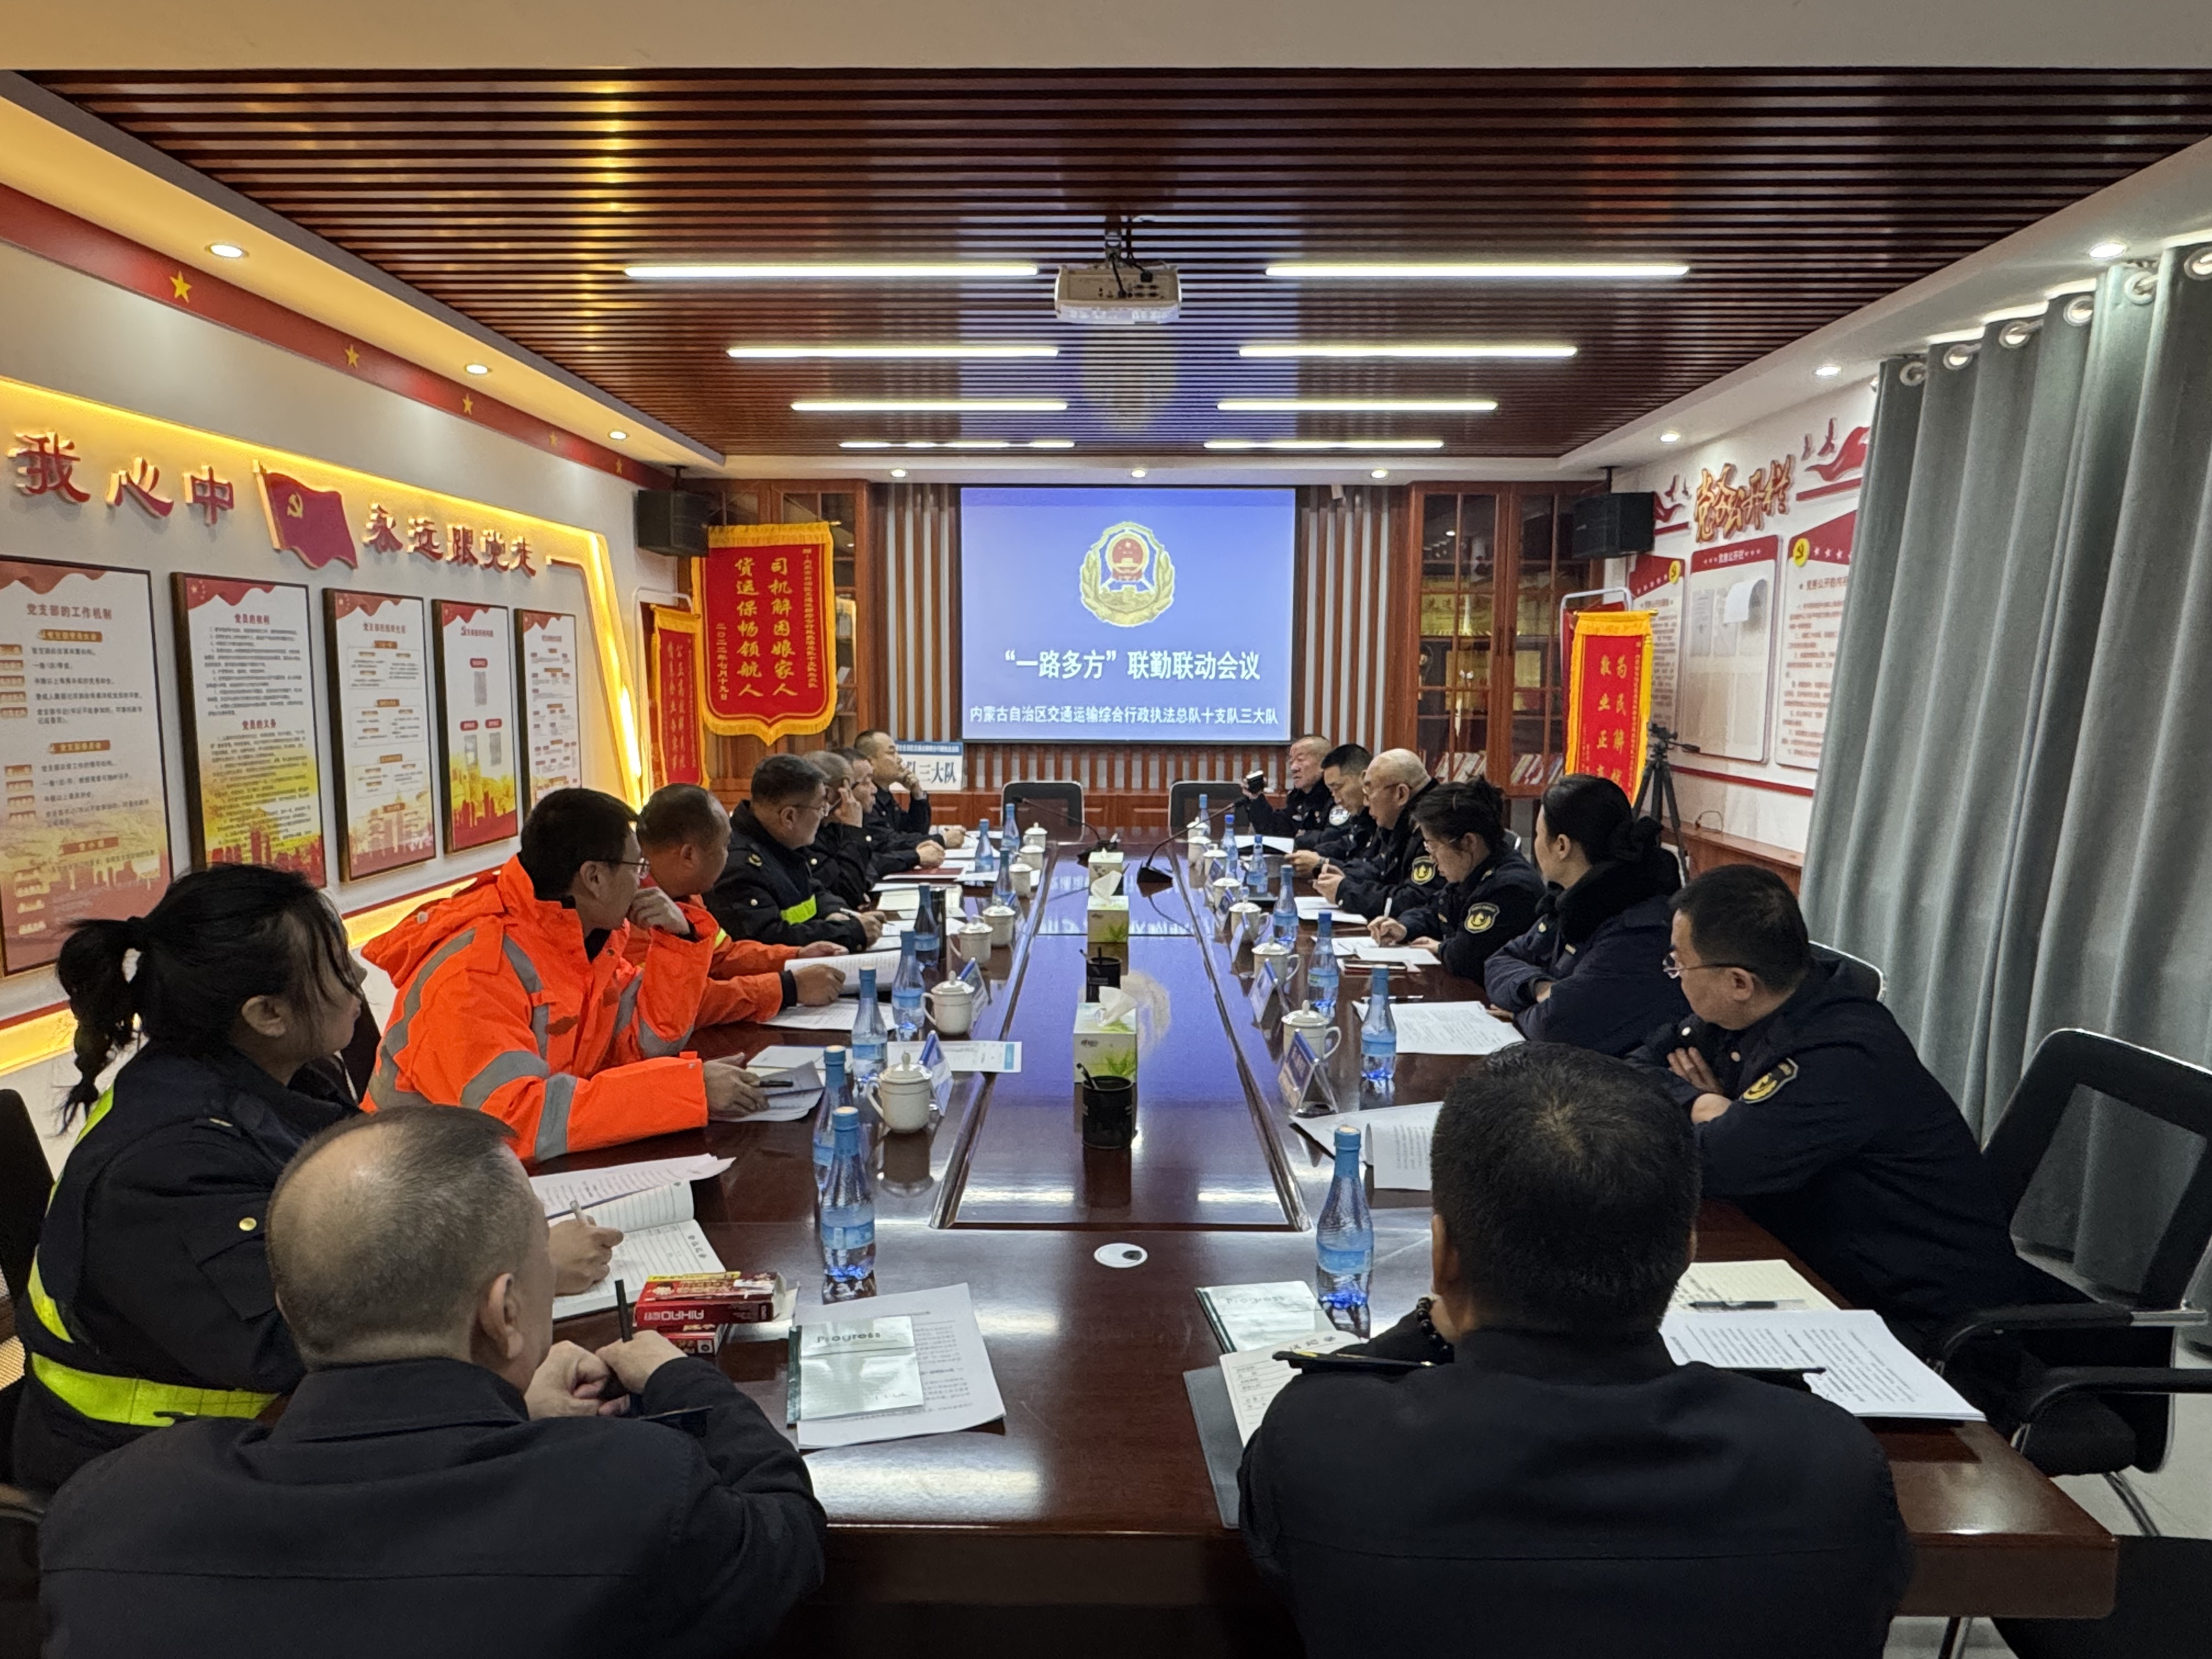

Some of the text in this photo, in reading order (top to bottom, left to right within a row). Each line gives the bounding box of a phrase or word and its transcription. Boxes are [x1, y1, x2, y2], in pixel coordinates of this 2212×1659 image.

[8, 431, 536, 576] 我心中 永远跟党走
[1695, 454, 1795, 543] 党务公开栏
[27, 603, 112, 620] 党支部的工作机制
[735, 557, 764, 697] 货运保畅领航人
[768, 557, 798, 697] 司机解困娘家人
[970, 706, 1278, 724] 内蒙古自治区交通运输综合行政执法总队十支队三大队
